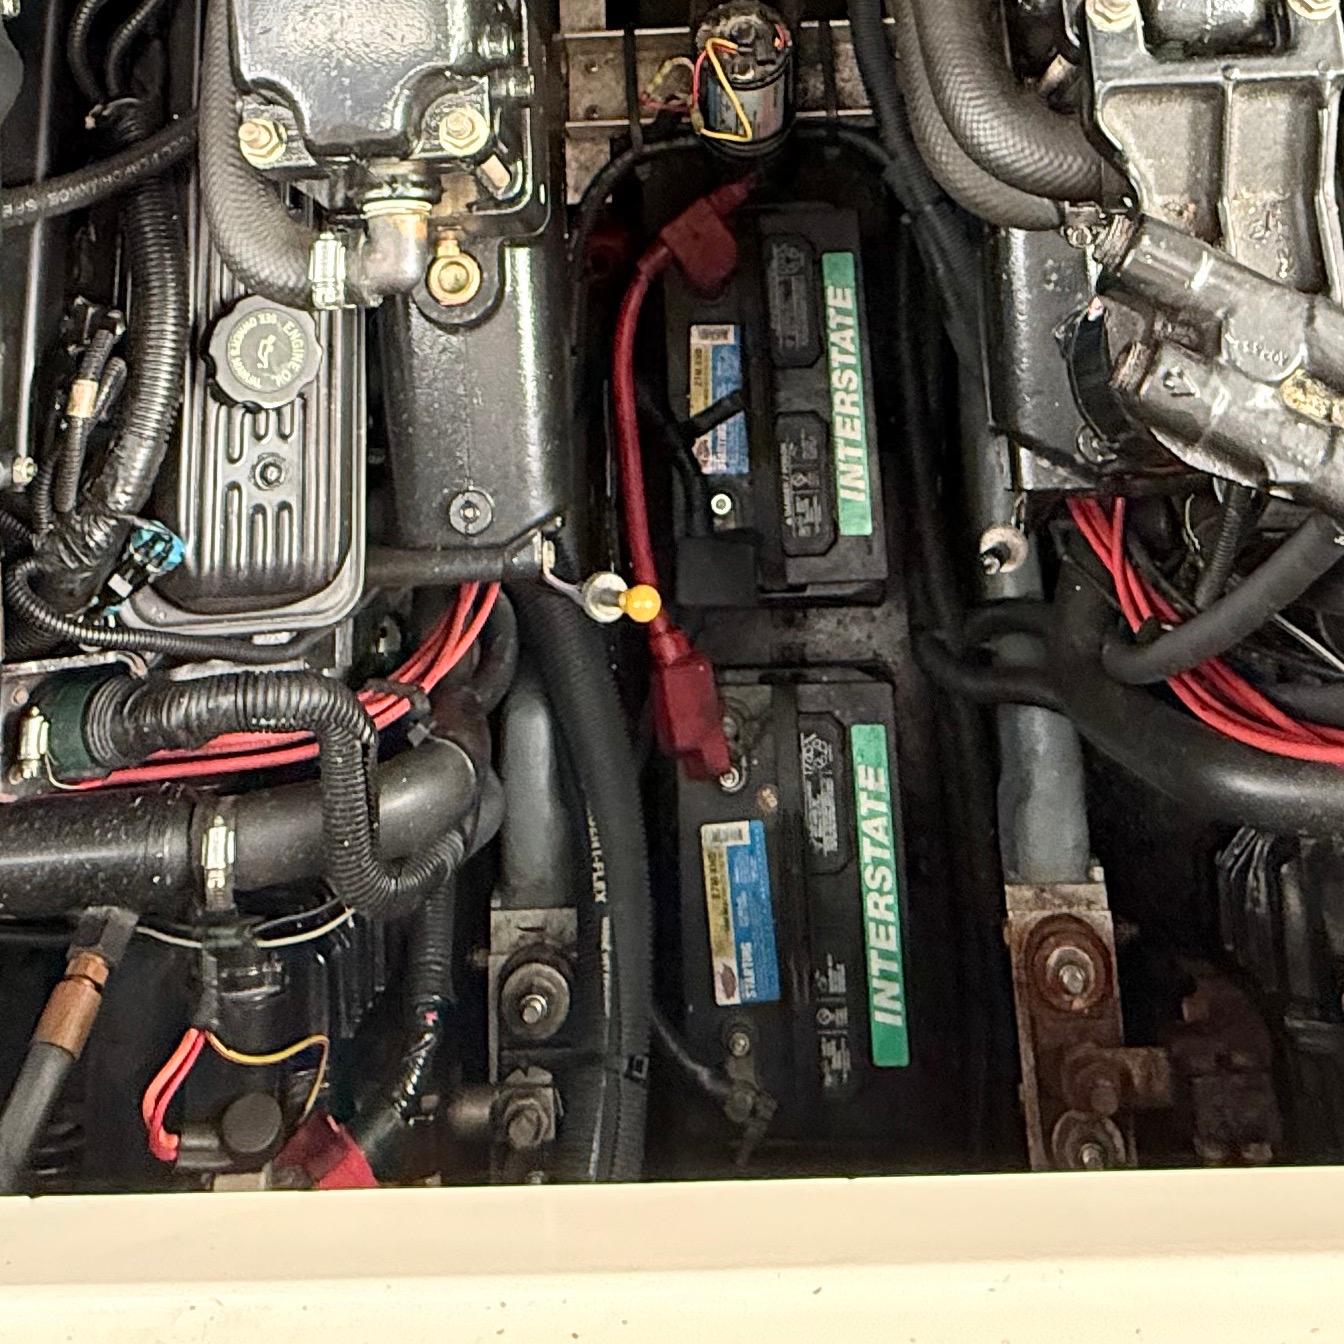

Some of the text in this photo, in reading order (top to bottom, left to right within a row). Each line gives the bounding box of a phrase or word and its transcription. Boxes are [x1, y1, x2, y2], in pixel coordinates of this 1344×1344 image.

[271, 320, 306, 388] ENGINE OIL
[826, 285, 867, 503] INTERSTATE
[857, 764, 904, 1027] INTERSTATE
